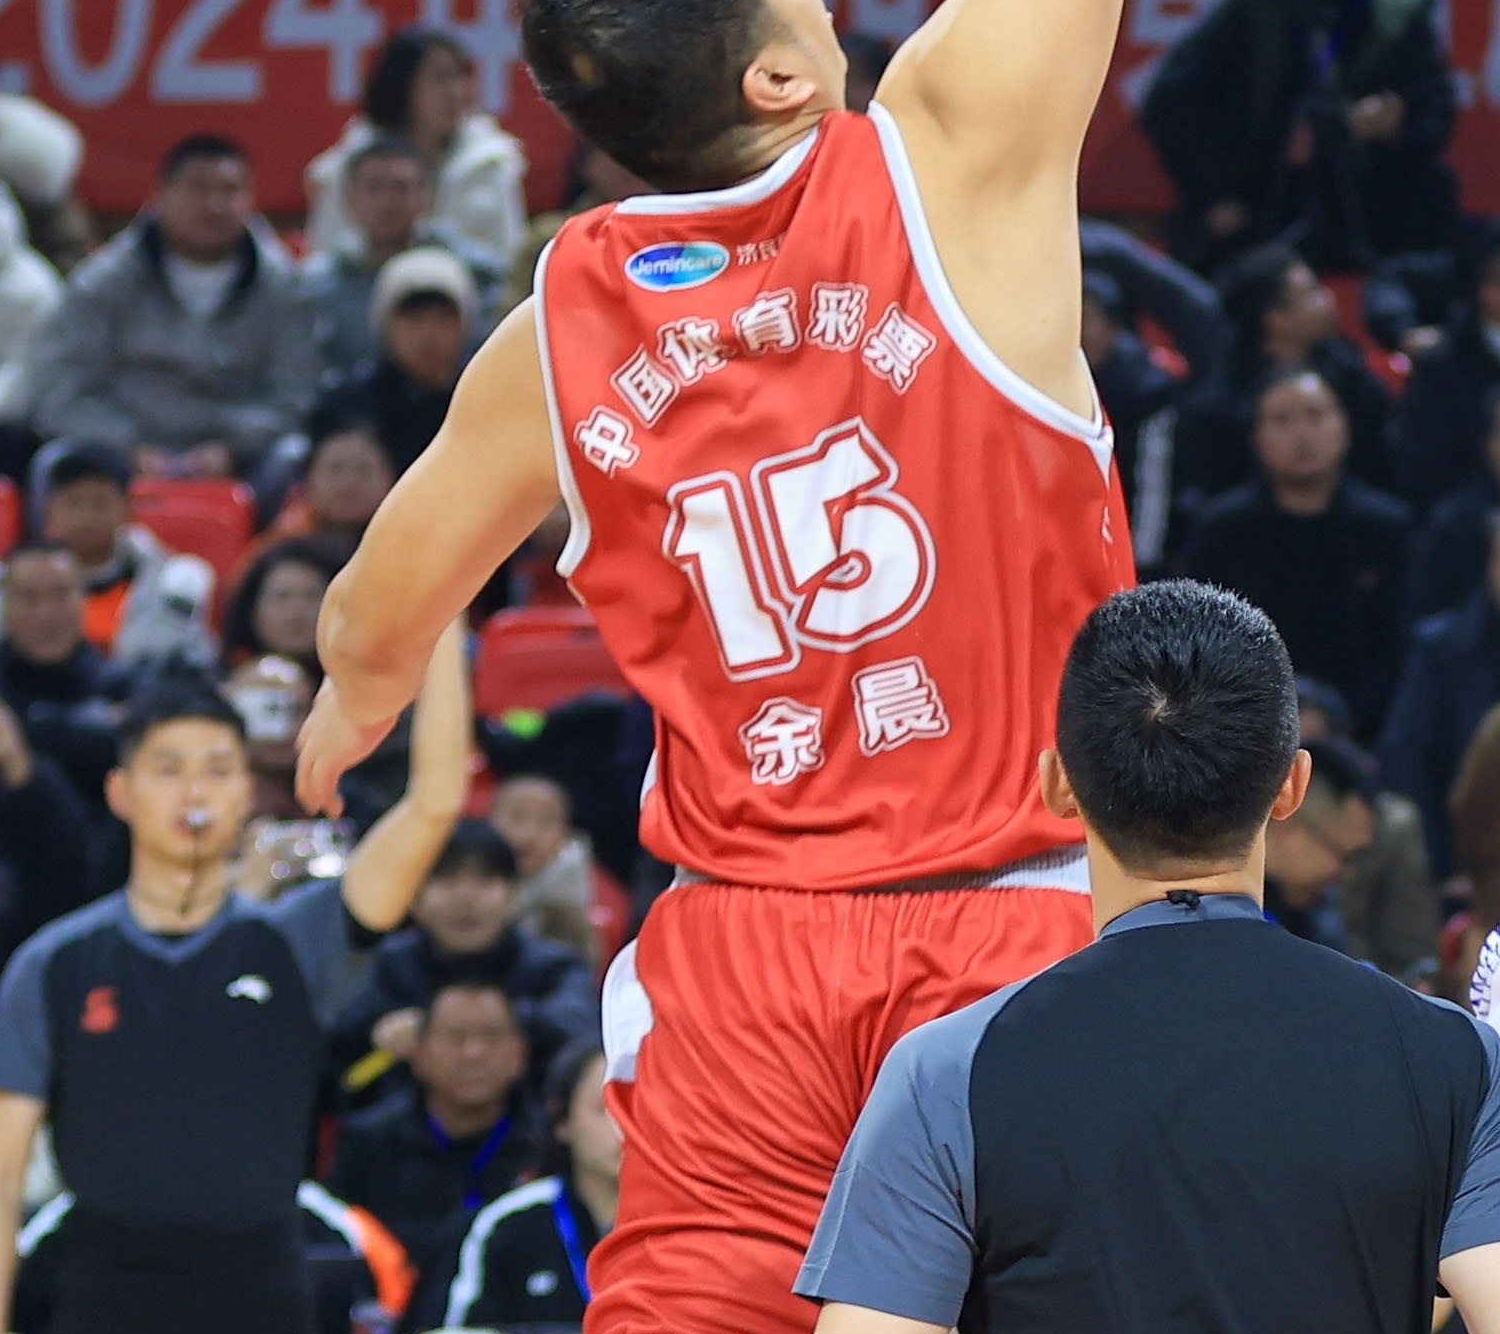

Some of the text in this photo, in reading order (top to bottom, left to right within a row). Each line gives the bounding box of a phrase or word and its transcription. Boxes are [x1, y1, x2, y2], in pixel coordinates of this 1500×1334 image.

[574, 281, 937, 477] 中国体育彩票
[663, 416, 935, 682] 15
[738, 655, 949, 786] 余晨
